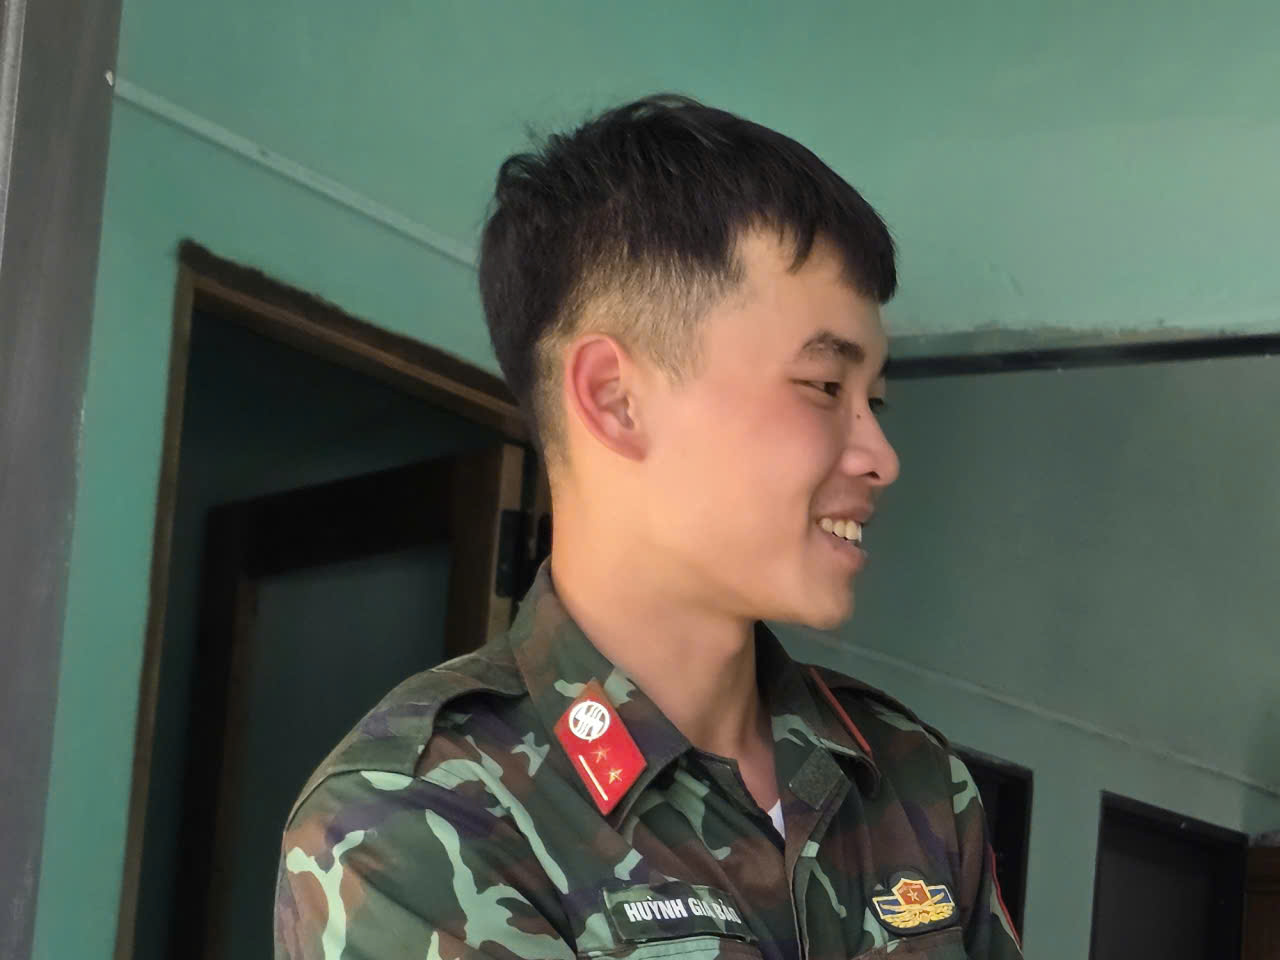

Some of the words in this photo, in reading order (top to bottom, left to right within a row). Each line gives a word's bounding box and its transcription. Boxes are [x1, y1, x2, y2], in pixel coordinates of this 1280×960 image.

[624, 895, 688, 922] HUỲNH
[688, 897, 716, 918] GIA
[711, 899, 742, 923] BẢO
